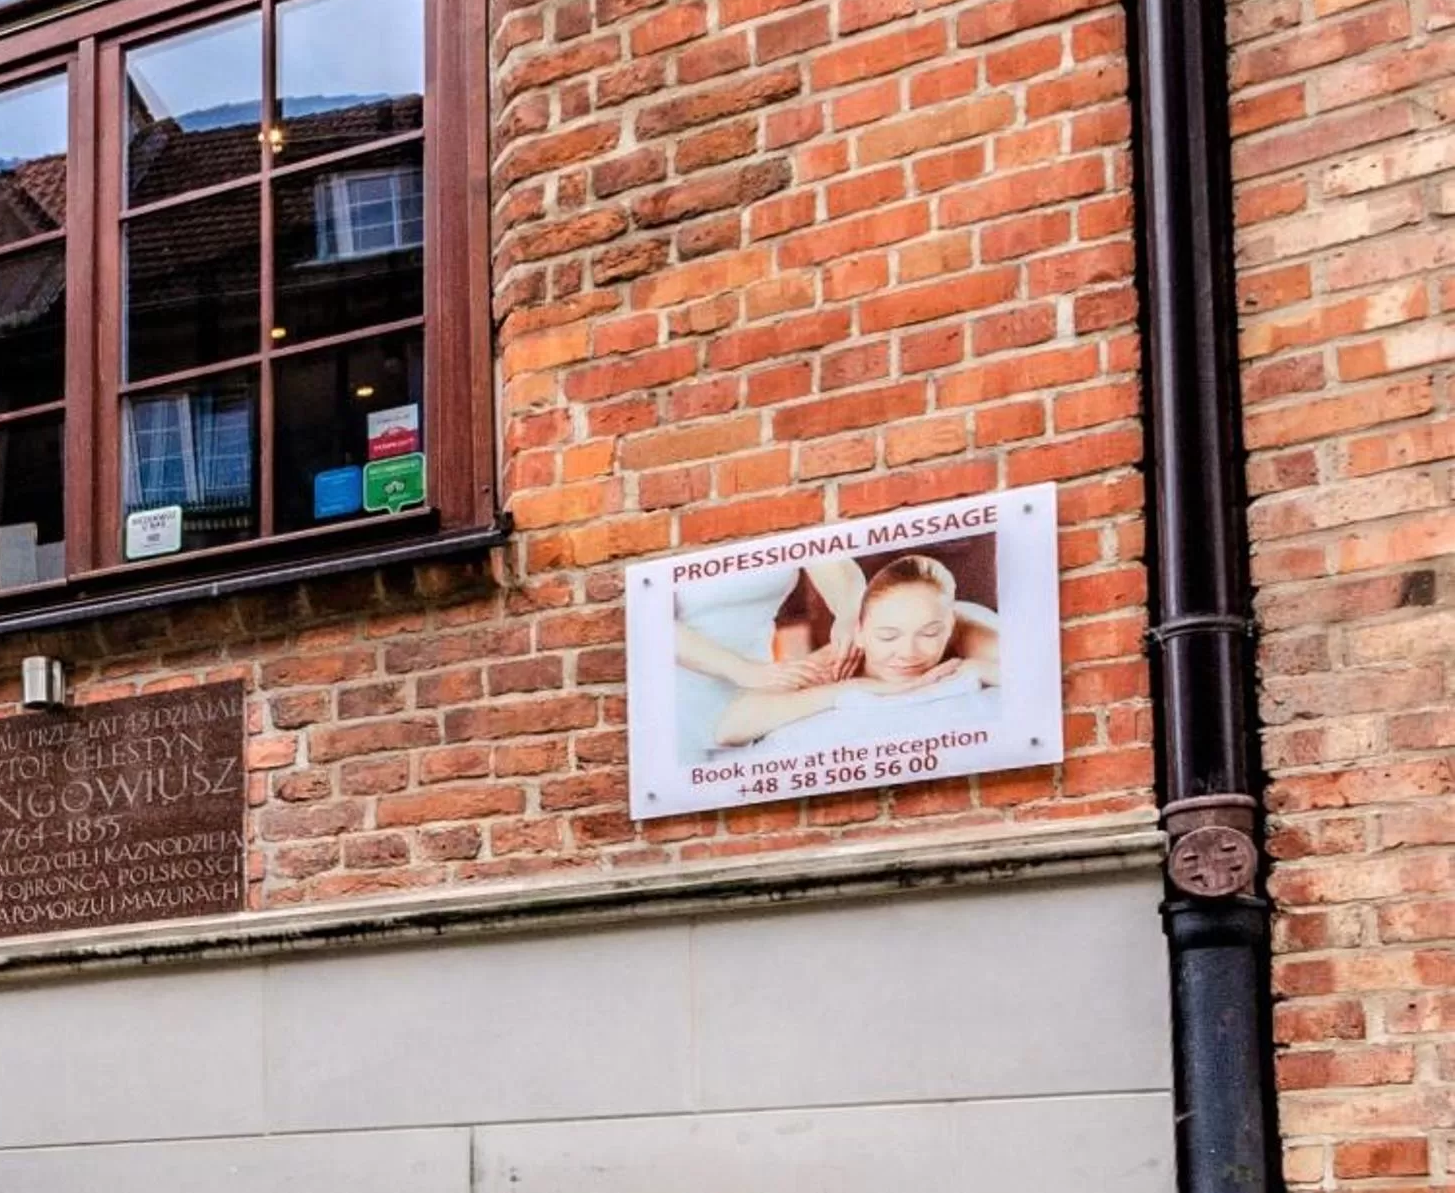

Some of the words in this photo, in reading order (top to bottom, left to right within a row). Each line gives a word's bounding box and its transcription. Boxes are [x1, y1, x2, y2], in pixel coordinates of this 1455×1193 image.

[672, 532, 860, 583] PROFESSIONAL
[866, 505, 998, 548] MASSAGE
[88, 714, 124, 738] LAT
[62, 731, 204, 773] CELESTYN
[691, 762, 746, 786] Book
[751, 757, 799, 776] now
[803, 751, 825, 770] at
[831, 745, 869, 764] the
[875, 728, 989, 760] reception
[736, 777, 779, 797] +48
[789, 771, 818, 791] 58
[824, 764, 867, 786] 506
[874, 760, 903, 779] 56
[908, 755, 939, 773] 00
[12, 896, 105, 926] POMORZU
[121, 880, 239, 910] MAZURACH
